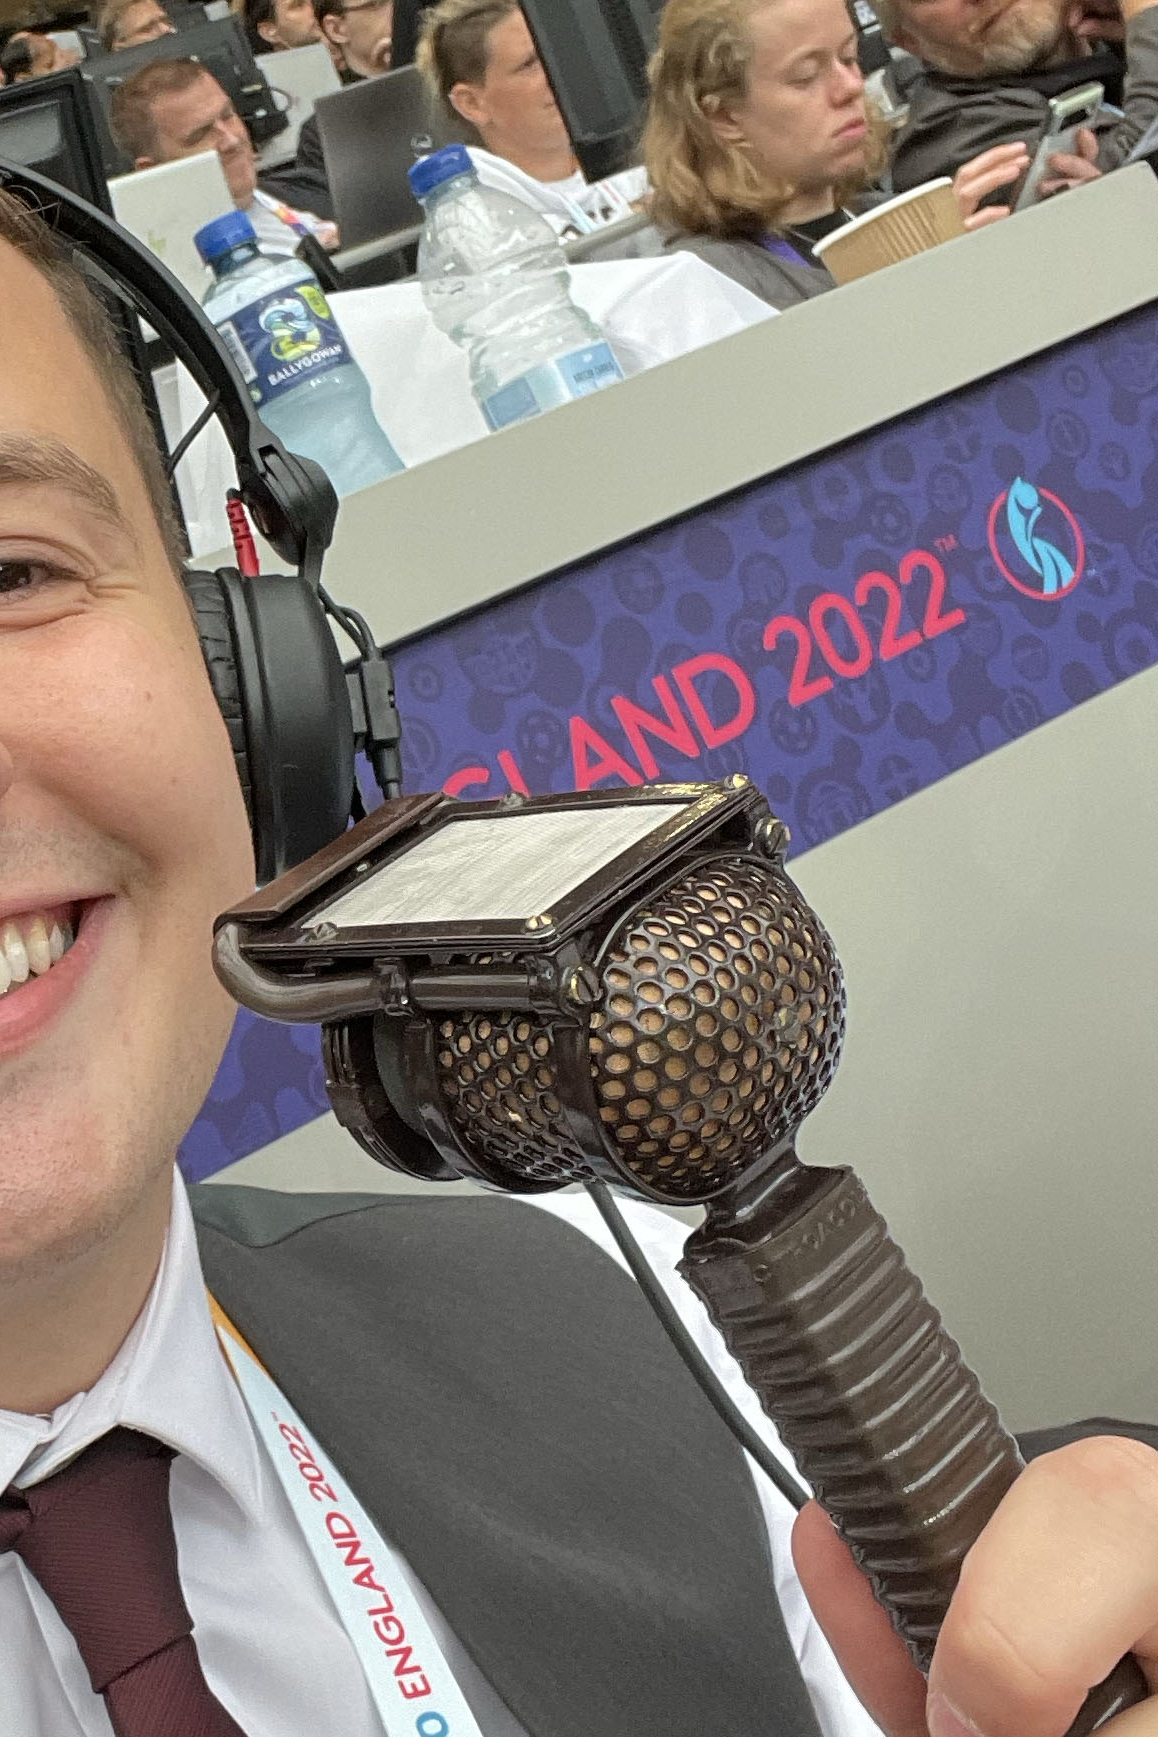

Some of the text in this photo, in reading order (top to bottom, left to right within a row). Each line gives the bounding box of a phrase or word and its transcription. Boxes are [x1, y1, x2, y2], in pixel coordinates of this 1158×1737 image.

[762, 548, 966, 708] 2022
[278, 1423, 339, 1502] 2022
[325, 1511, 432, 1700] ENGLAND
